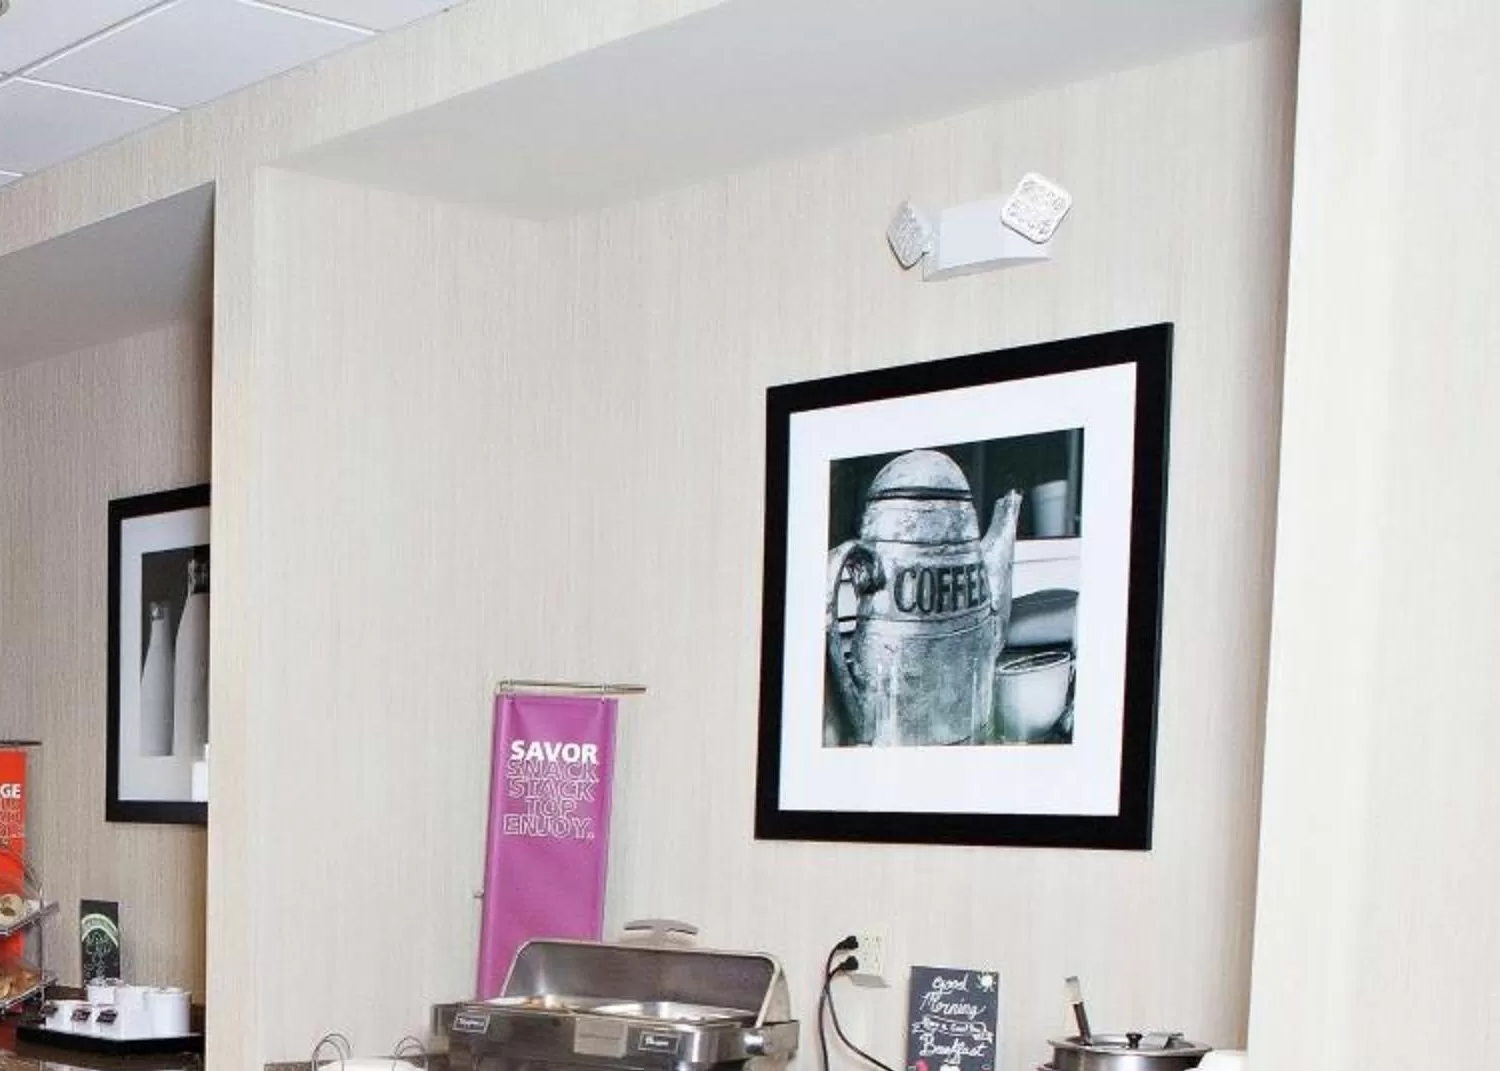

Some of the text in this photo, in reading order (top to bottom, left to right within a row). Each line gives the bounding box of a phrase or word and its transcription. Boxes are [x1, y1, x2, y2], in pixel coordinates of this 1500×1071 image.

[511, 740, 599, 765] SAVOR
[506, 759, 599, 783] SNACK
[508, 778, 595, 801] STACK
[524, 799, 578, 818] TOP
